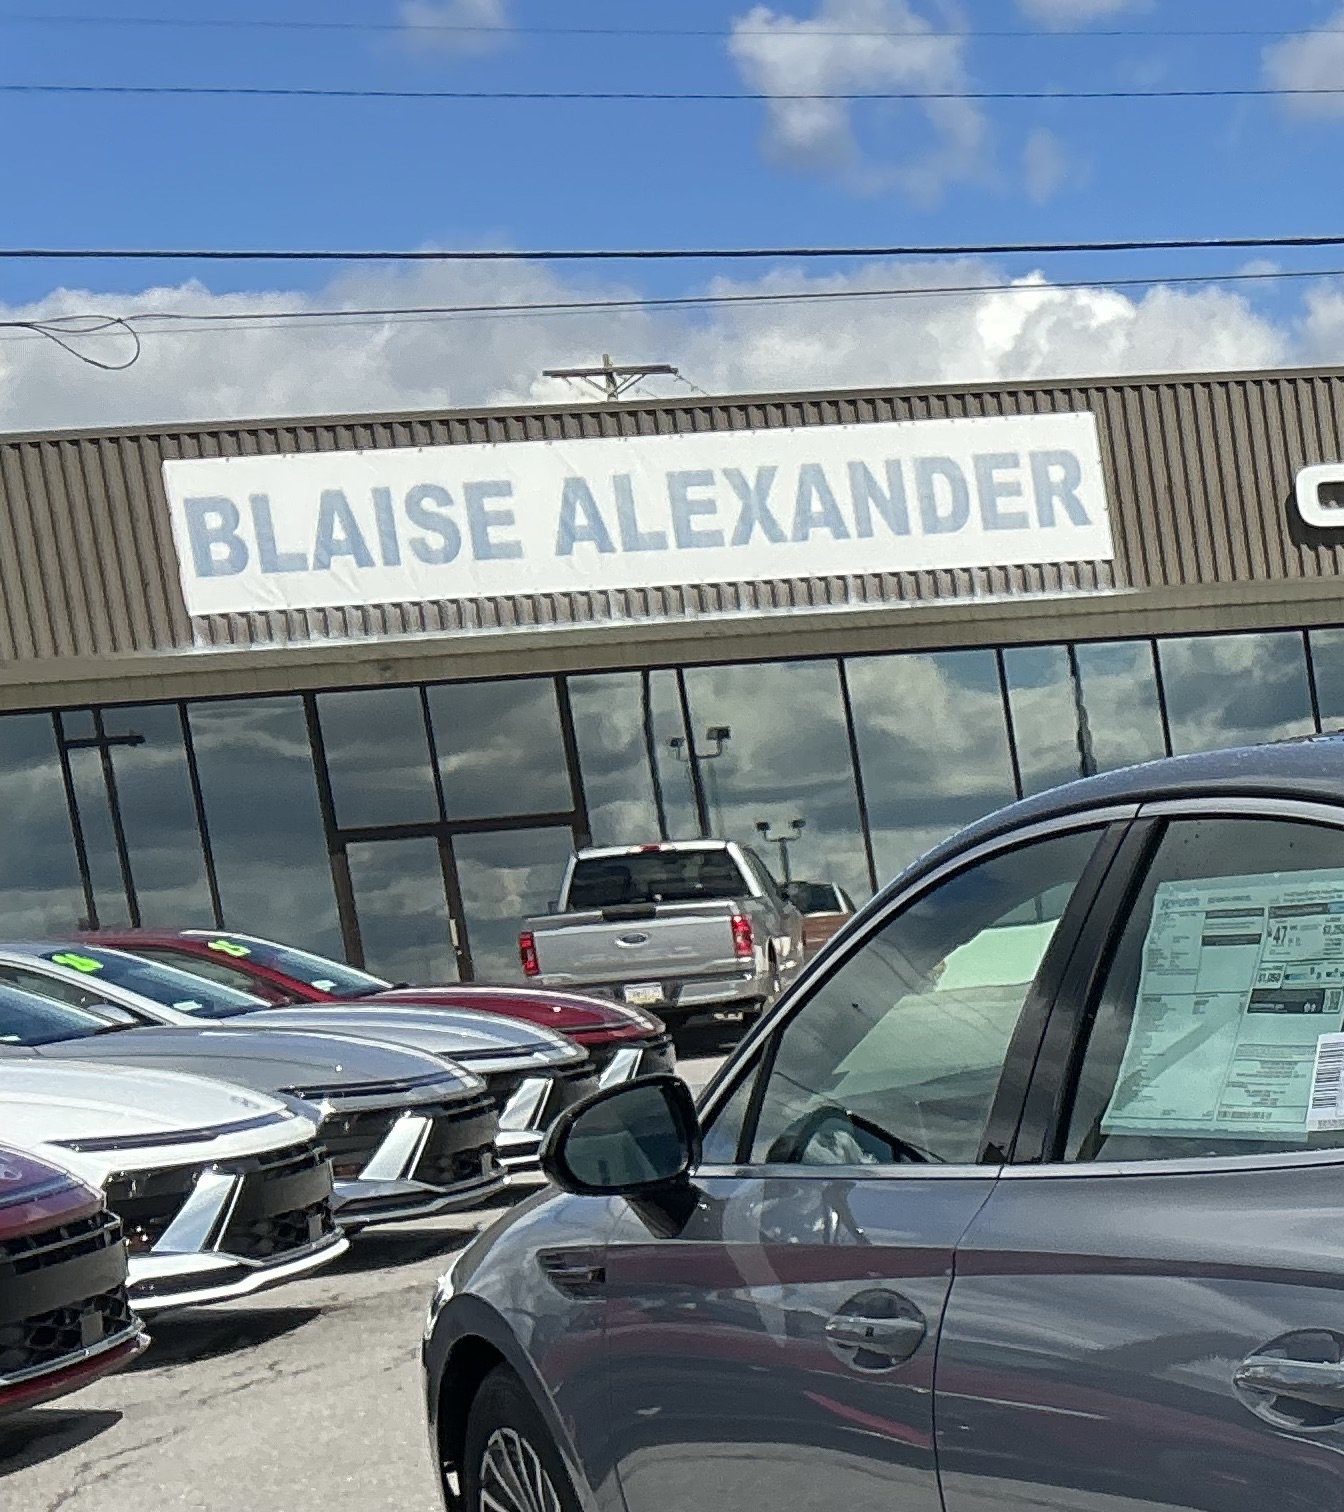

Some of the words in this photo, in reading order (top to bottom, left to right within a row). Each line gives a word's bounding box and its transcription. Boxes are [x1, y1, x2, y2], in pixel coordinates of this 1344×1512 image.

[184, 480, 524, 578] BLAISE
[554, 448, 1093, 557] ALEXANDER
[1272, 926, 1288, 945] 47
